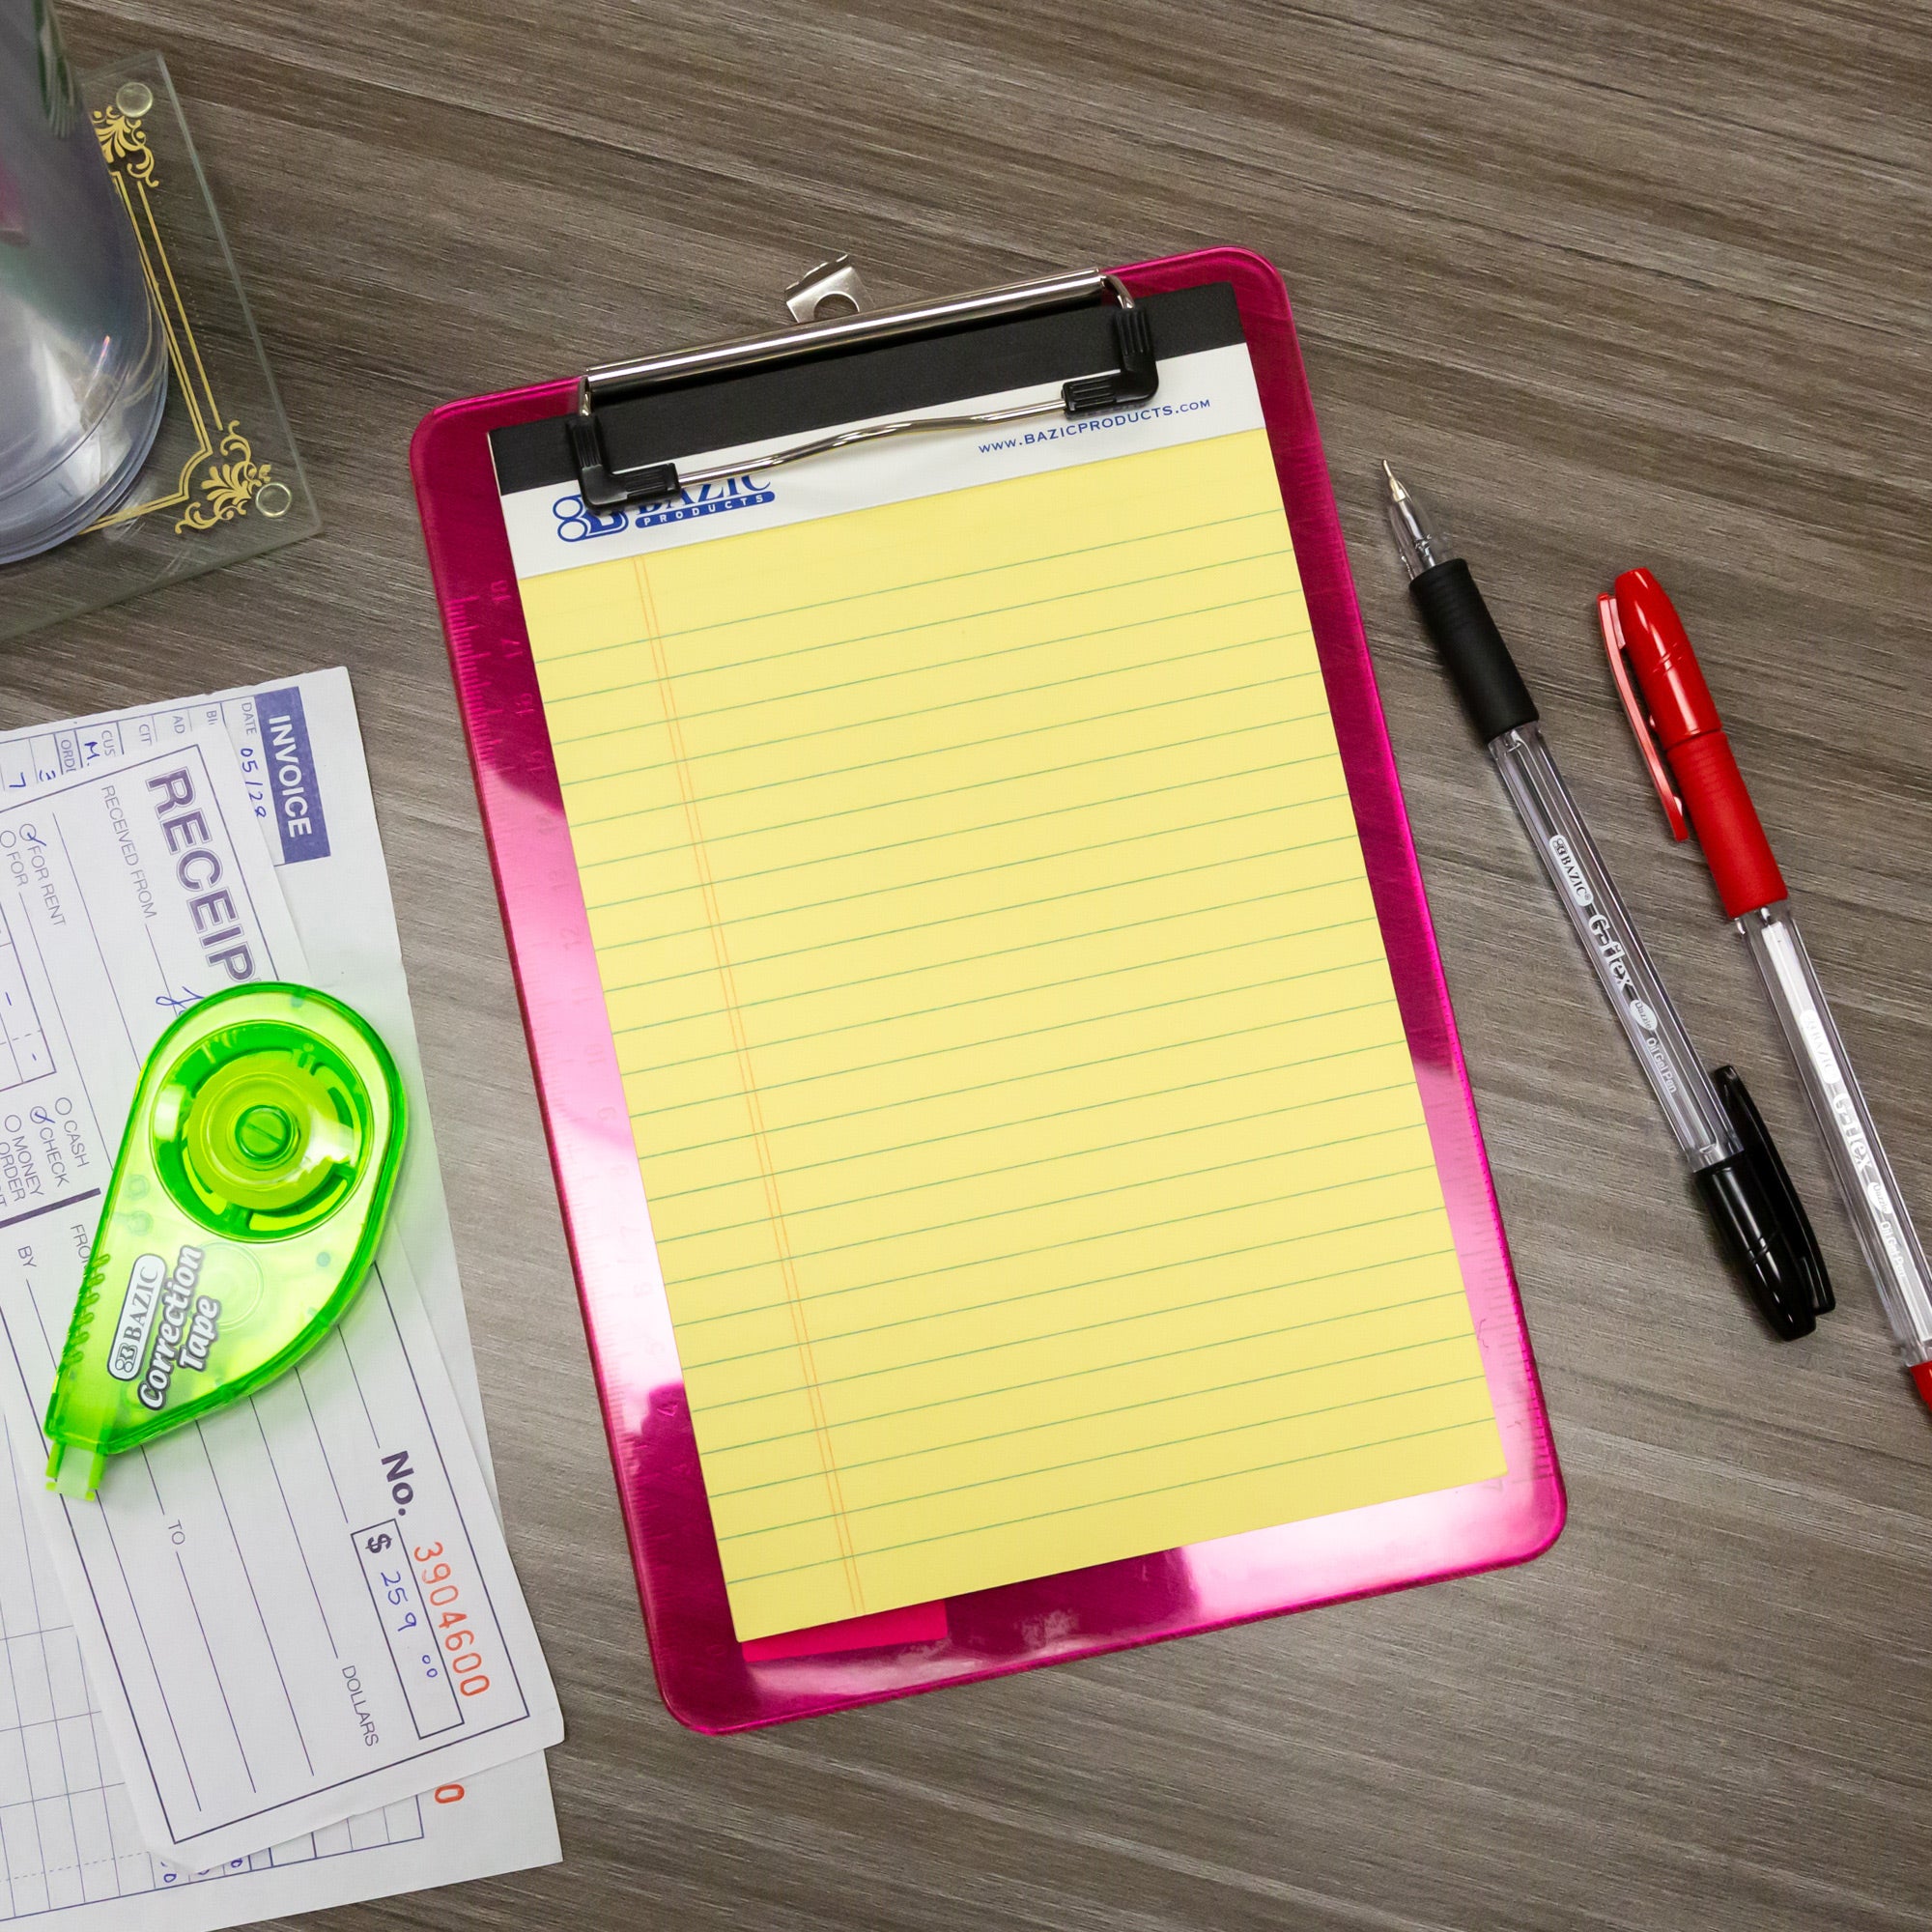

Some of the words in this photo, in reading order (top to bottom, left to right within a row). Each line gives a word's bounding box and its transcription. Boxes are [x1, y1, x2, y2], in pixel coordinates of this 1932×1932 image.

[643, 495, 764, 526] PRODUCTS
[242, 701, 258, 736] DATE
[268, 714, 313, 838] INVOICE
[6, 851, 29, 888] FOR
[27, 845, 49, 881] FOR
[41, 883, 67, 925] RENT
[101, 784, 139, 867] RECEIVED
[130, 869, 157, 919] FROM
[145, 766, 259, 982] RECEIP
[1589, 913, 1634, 994] G-flex
[1646, 1037, 1660, 1055] Oil
[1654, 1052, 1669, 1071] Gel
[1662, 1070, 1678, 1094] Pen
[12, 1135, 45, 1196] MONEY
[39, 1126, 71, 1188] CHECK
[64, 1120, 90, 1168] CASH
[1833, 1092, 1874, 1175] G-flex
[17, 1245, 38, 1268] BY
[70, 1223, 94, 1265] FRO
[123, 1265, 158, 1343] BAZIC
[138, 1245, 204, 1410] Correction
[179, 1295, 220, 1371] Tape
[167, 1519, 186, 1546] TO
[381, 1450, 415, 1517] No.
[413, 1541, 491, 1697] 3904600
[381, 1571, 417, 1633] 259
[341, 1664, 380, 1747] DOLLARS
